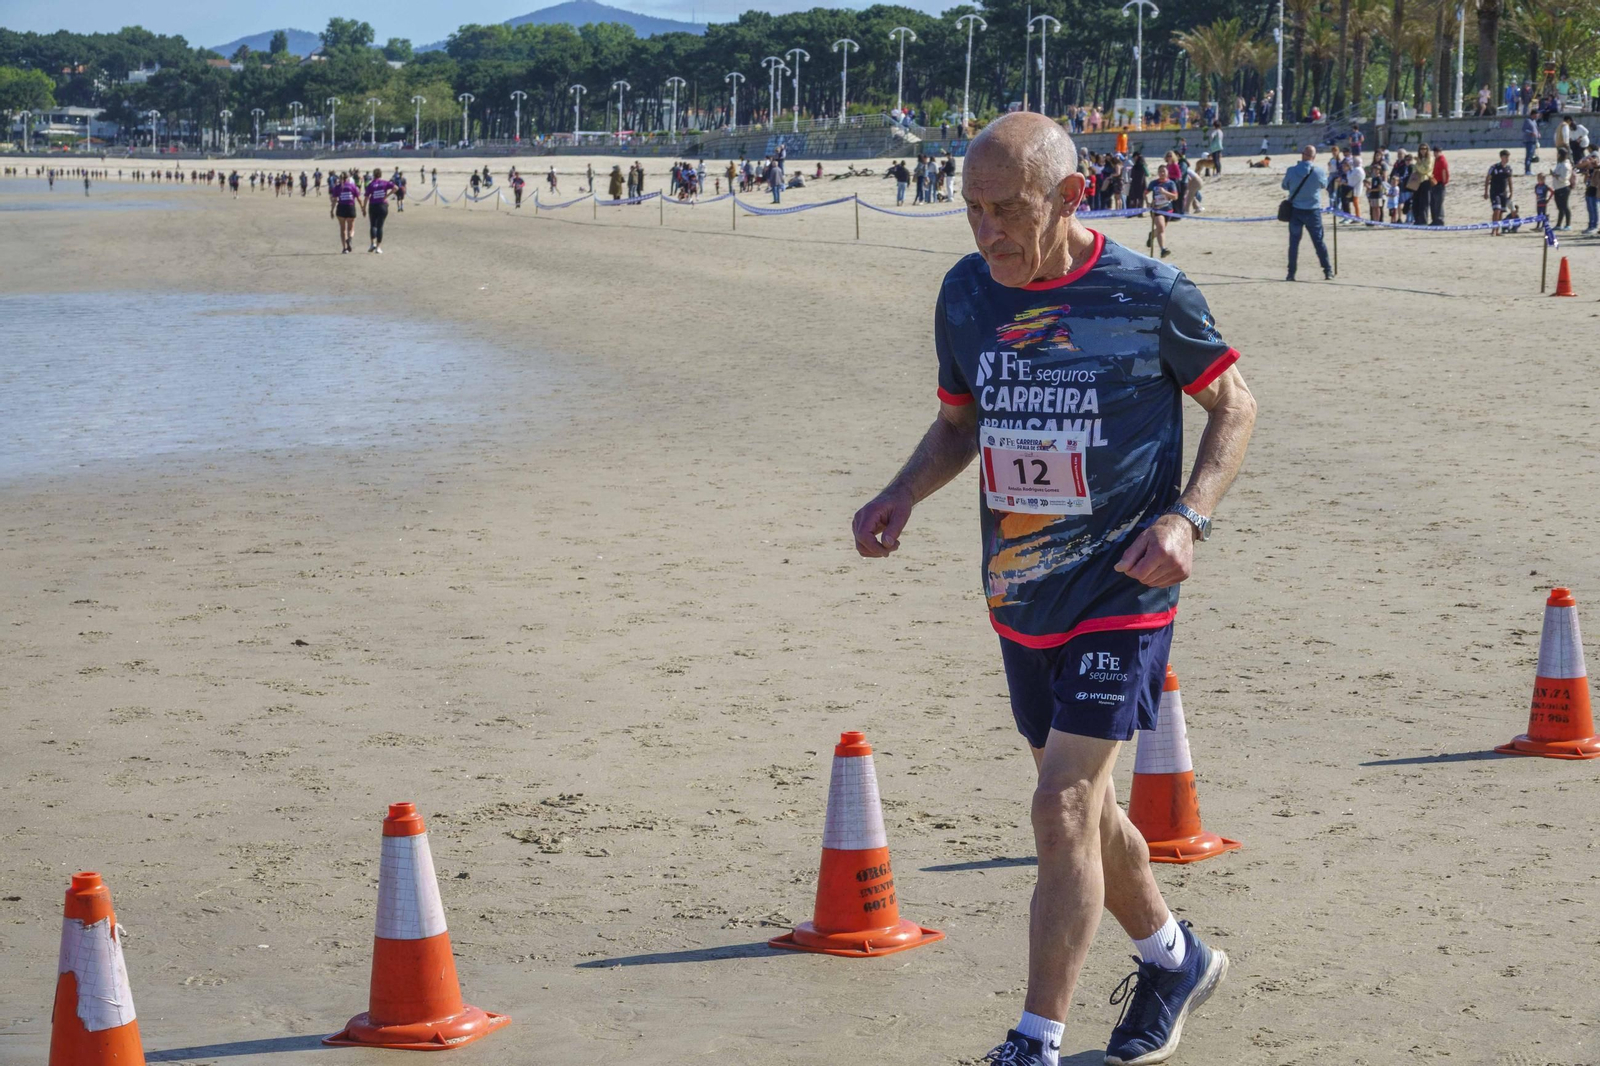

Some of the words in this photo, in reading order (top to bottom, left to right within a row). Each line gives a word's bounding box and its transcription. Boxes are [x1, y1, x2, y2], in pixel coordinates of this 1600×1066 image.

[1035, 368, 1097, 386] seguros
[980, 385, 1099, 414] CARREIRA
[1012, 458, 1051, 486] 12
[1089, 671, 1128, 683] seguros
[1089, 692, 1125, 702] HYUNDAI
